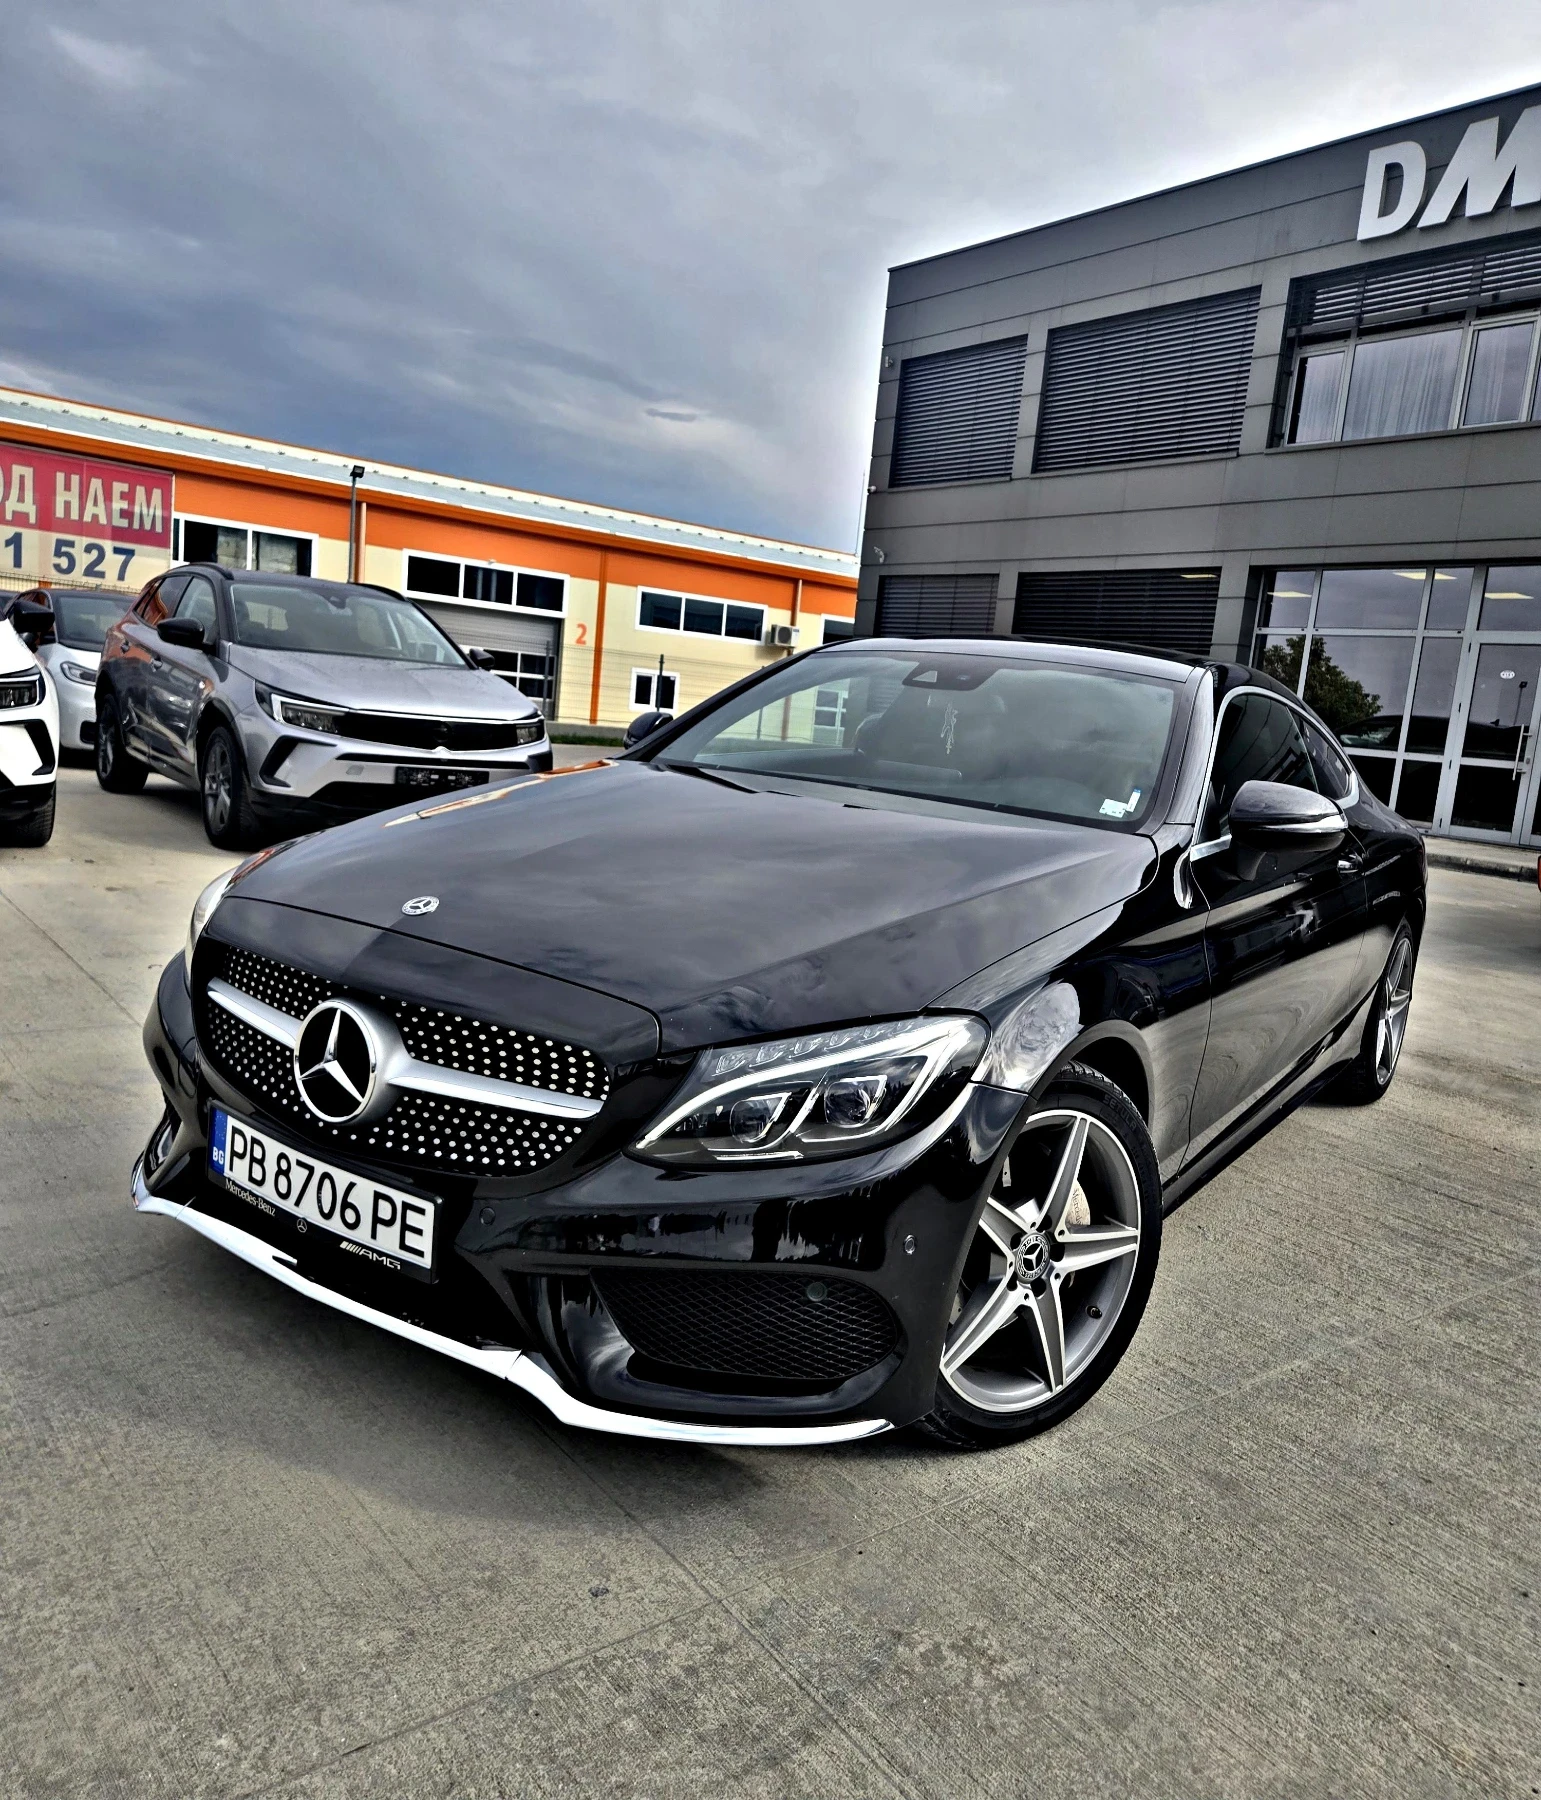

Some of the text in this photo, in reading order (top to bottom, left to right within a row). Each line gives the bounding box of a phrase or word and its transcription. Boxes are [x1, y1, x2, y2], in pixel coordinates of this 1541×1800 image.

[0, 464, 163, 533] Д НАЕМ
[5, 532, 136, 582] 1 527
[575, 623, 588, 645] 2
[212, 1146, 224, 1165] BG
[225, 1178, 276, 1217] Mercedes-Benz
[229, 1125, 426, 1259] PB 8706 PE
[359, 1248, 401, 1270] AMG
